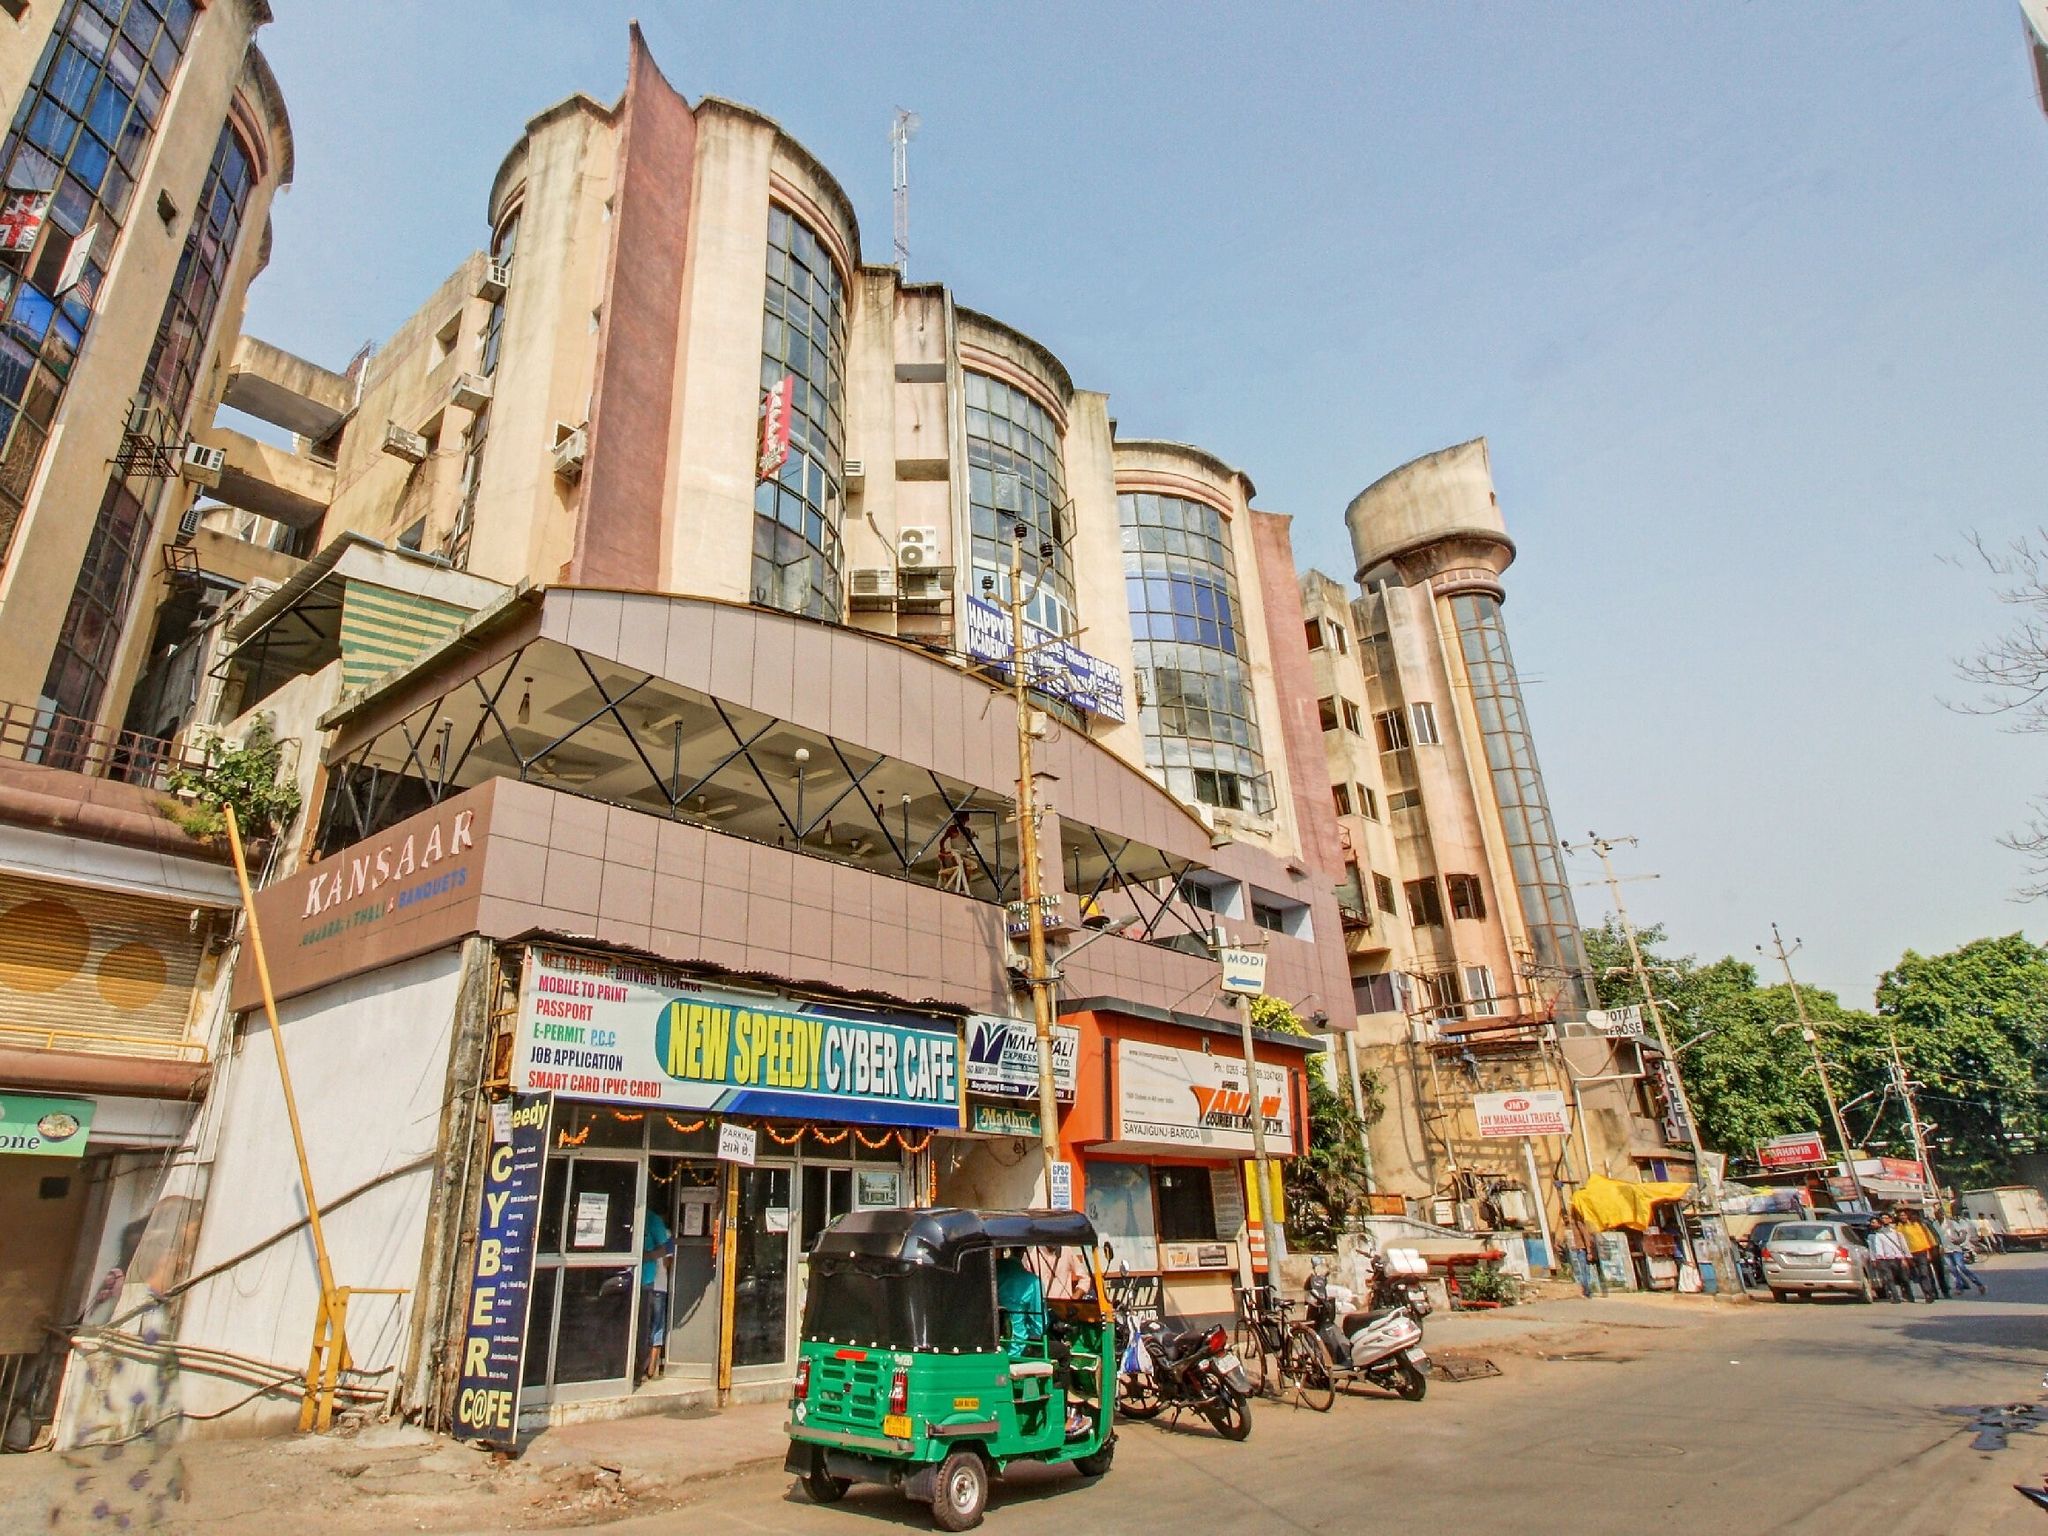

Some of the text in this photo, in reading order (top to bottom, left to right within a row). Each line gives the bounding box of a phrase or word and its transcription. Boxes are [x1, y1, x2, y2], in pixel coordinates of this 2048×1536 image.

[302, 810, 474, 919] KANSAAR
[1228, 953, 1264, 967] MODI
[615, 966, 657, 985] DRIVING
[538, 974, 628, 1004] MOBILE TO PRINT
[536, 998, 593, 1021] PASSPORT
[667, 1001, 956, 1102] NEW SPEEDY CYBER CAFE
[1003, 1051, 1037, 1062] EXPRESS
[1005, 1033, 1075, 1058] MAHALI
[530, 1046, 623, 1072] JOB APPLICATION
[528, 1070, 662, 1099] SMART CARD (PVC CARD)
[512, 1100, 549, 1130] eedy
[1210, 1088, 1282, 1118] ANJNI
[1506, 1100, 1527, 1110] JMT
[1530, 1111, 1561, 1123] TRAVELS
[722, 1127, 754, 1143] PARKING
[459, 1387, 514, 1430] C@FE
